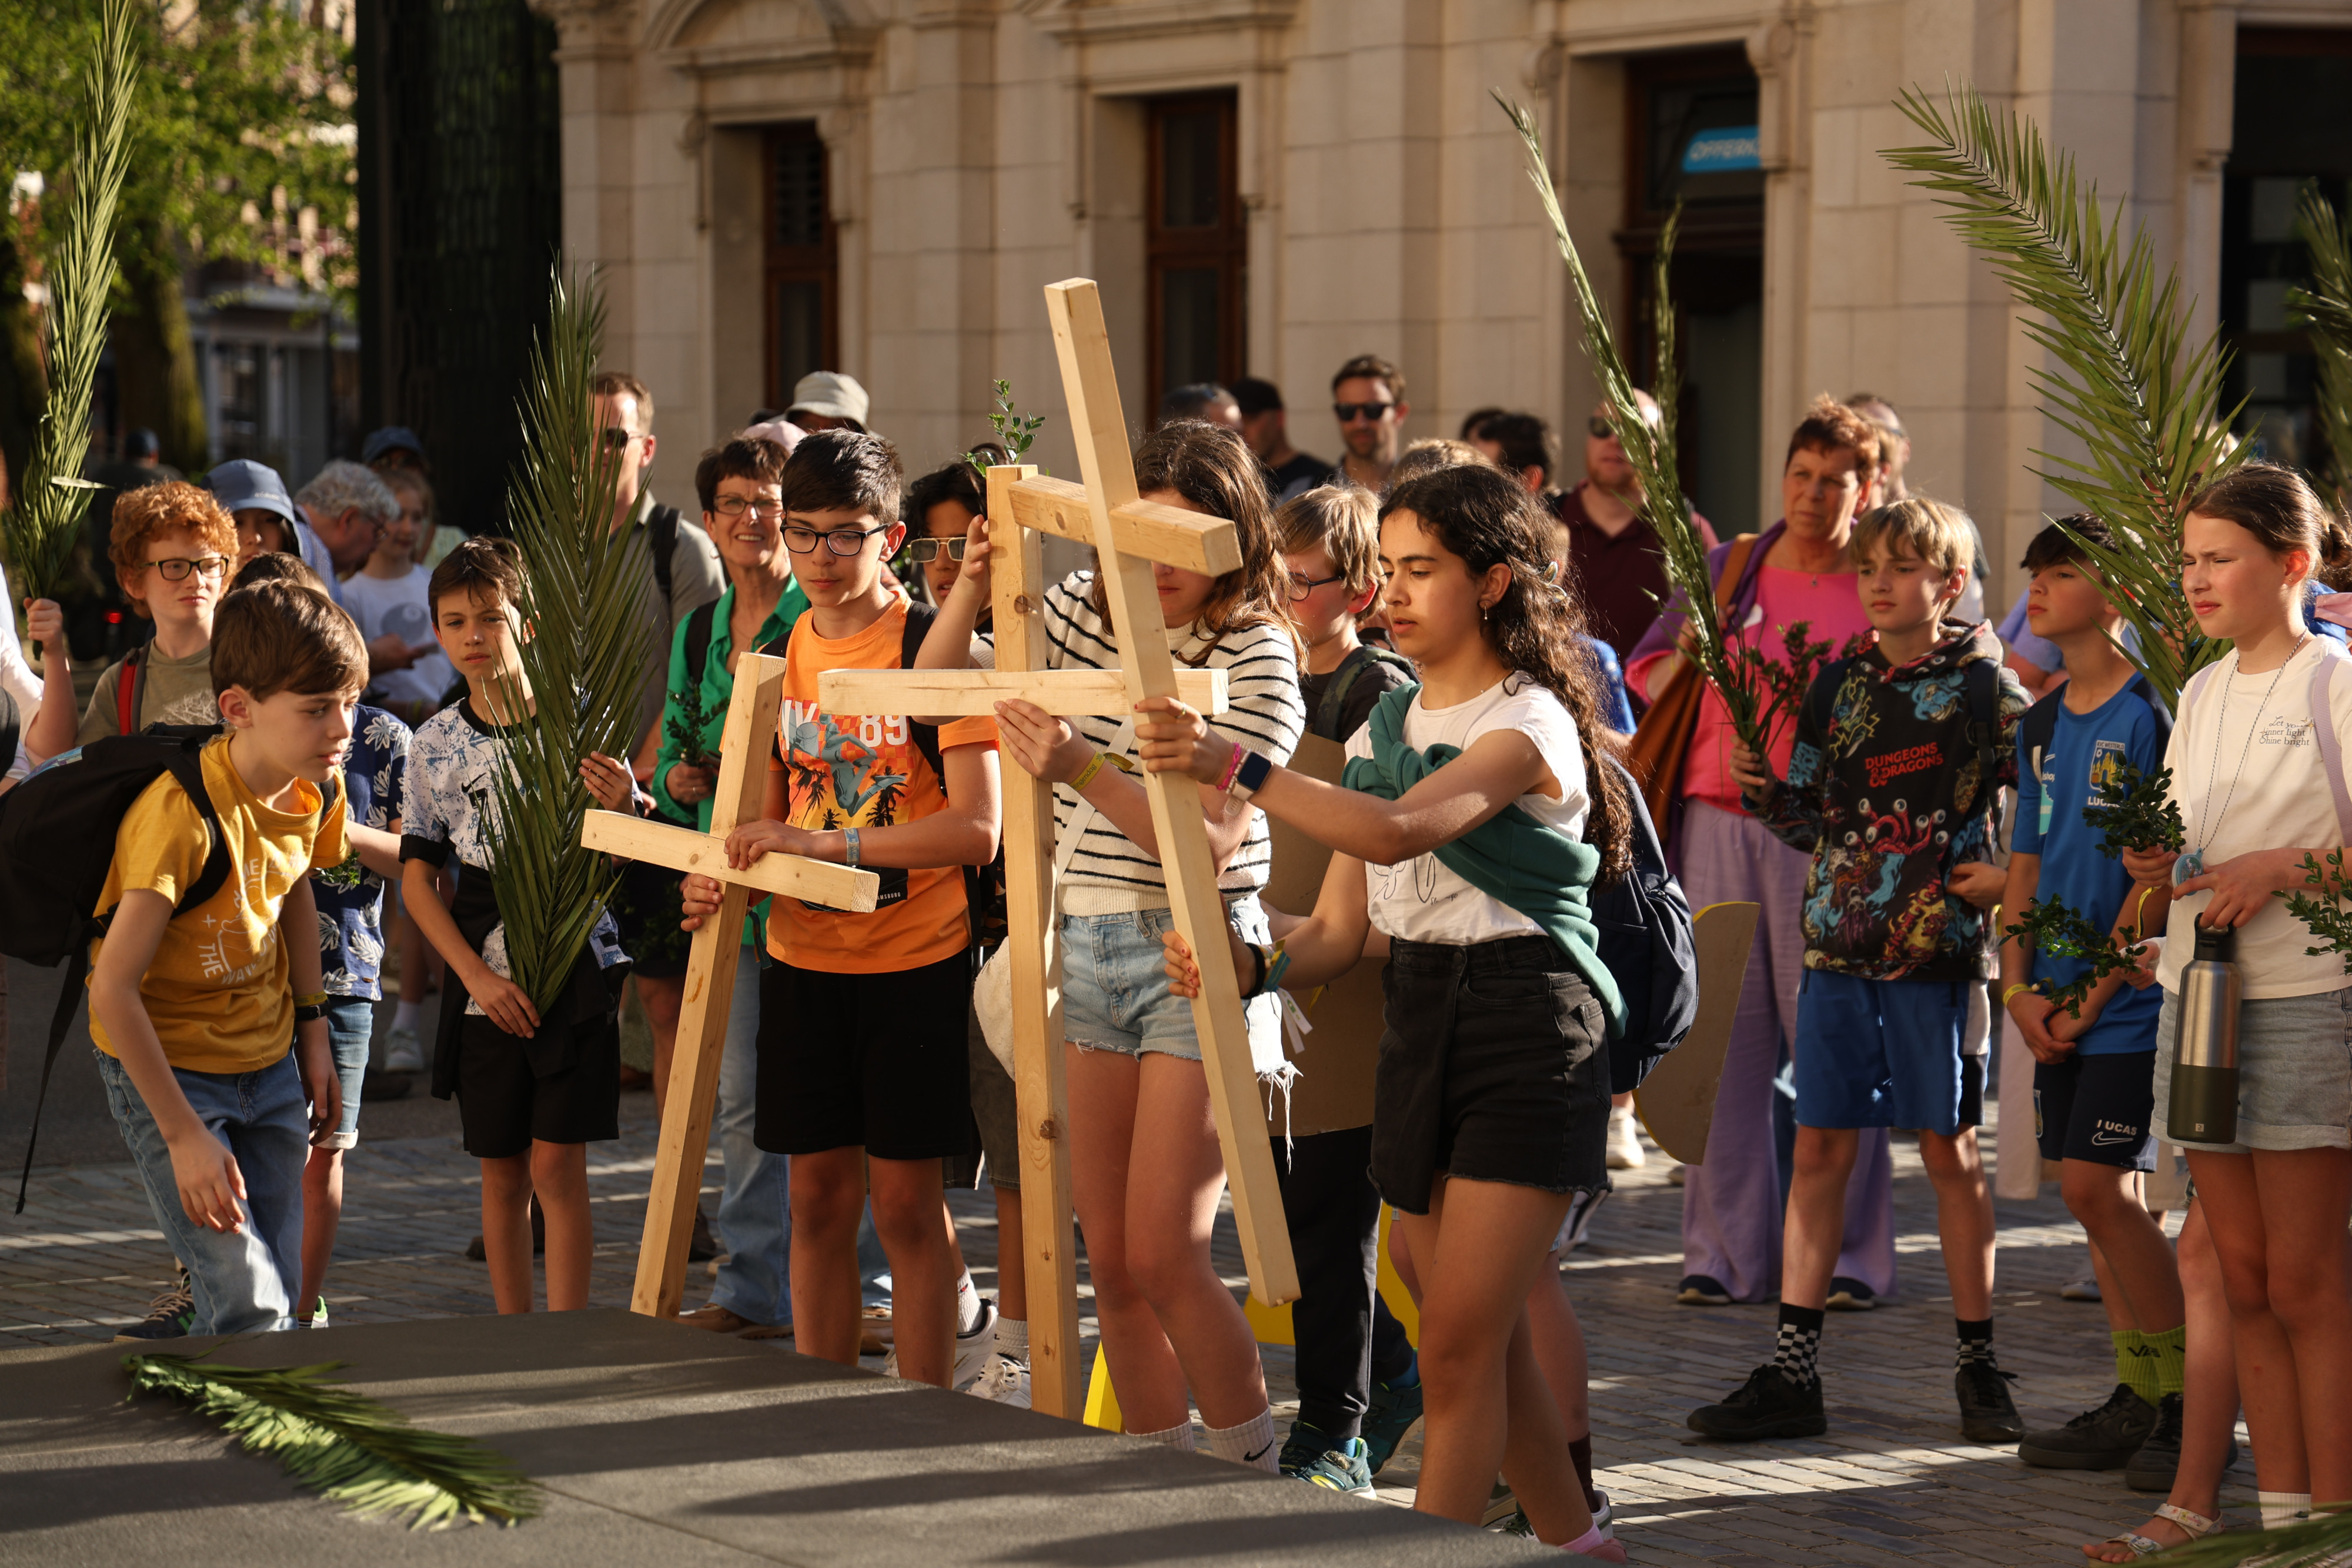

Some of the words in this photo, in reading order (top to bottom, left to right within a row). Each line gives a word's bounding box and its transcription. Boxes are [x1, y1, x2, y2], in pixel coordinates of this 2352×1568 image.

[860, 715, 907, 748] 89
[2269, 716, 2284, 727] Let
[2259, 733, 2281, 744] Shine
[2284, 736, 2310, 748] bright
[2266, 727, 2284, 735] inner
[2286, 728, 2306, 740] light
[1865, 741, 1939, 770] DUNGEONS
[1881, 753, 1944, 779] DRAGONS
[2088, 795, 2120, 808] LUC
[198, 942, 223, 978] THE
